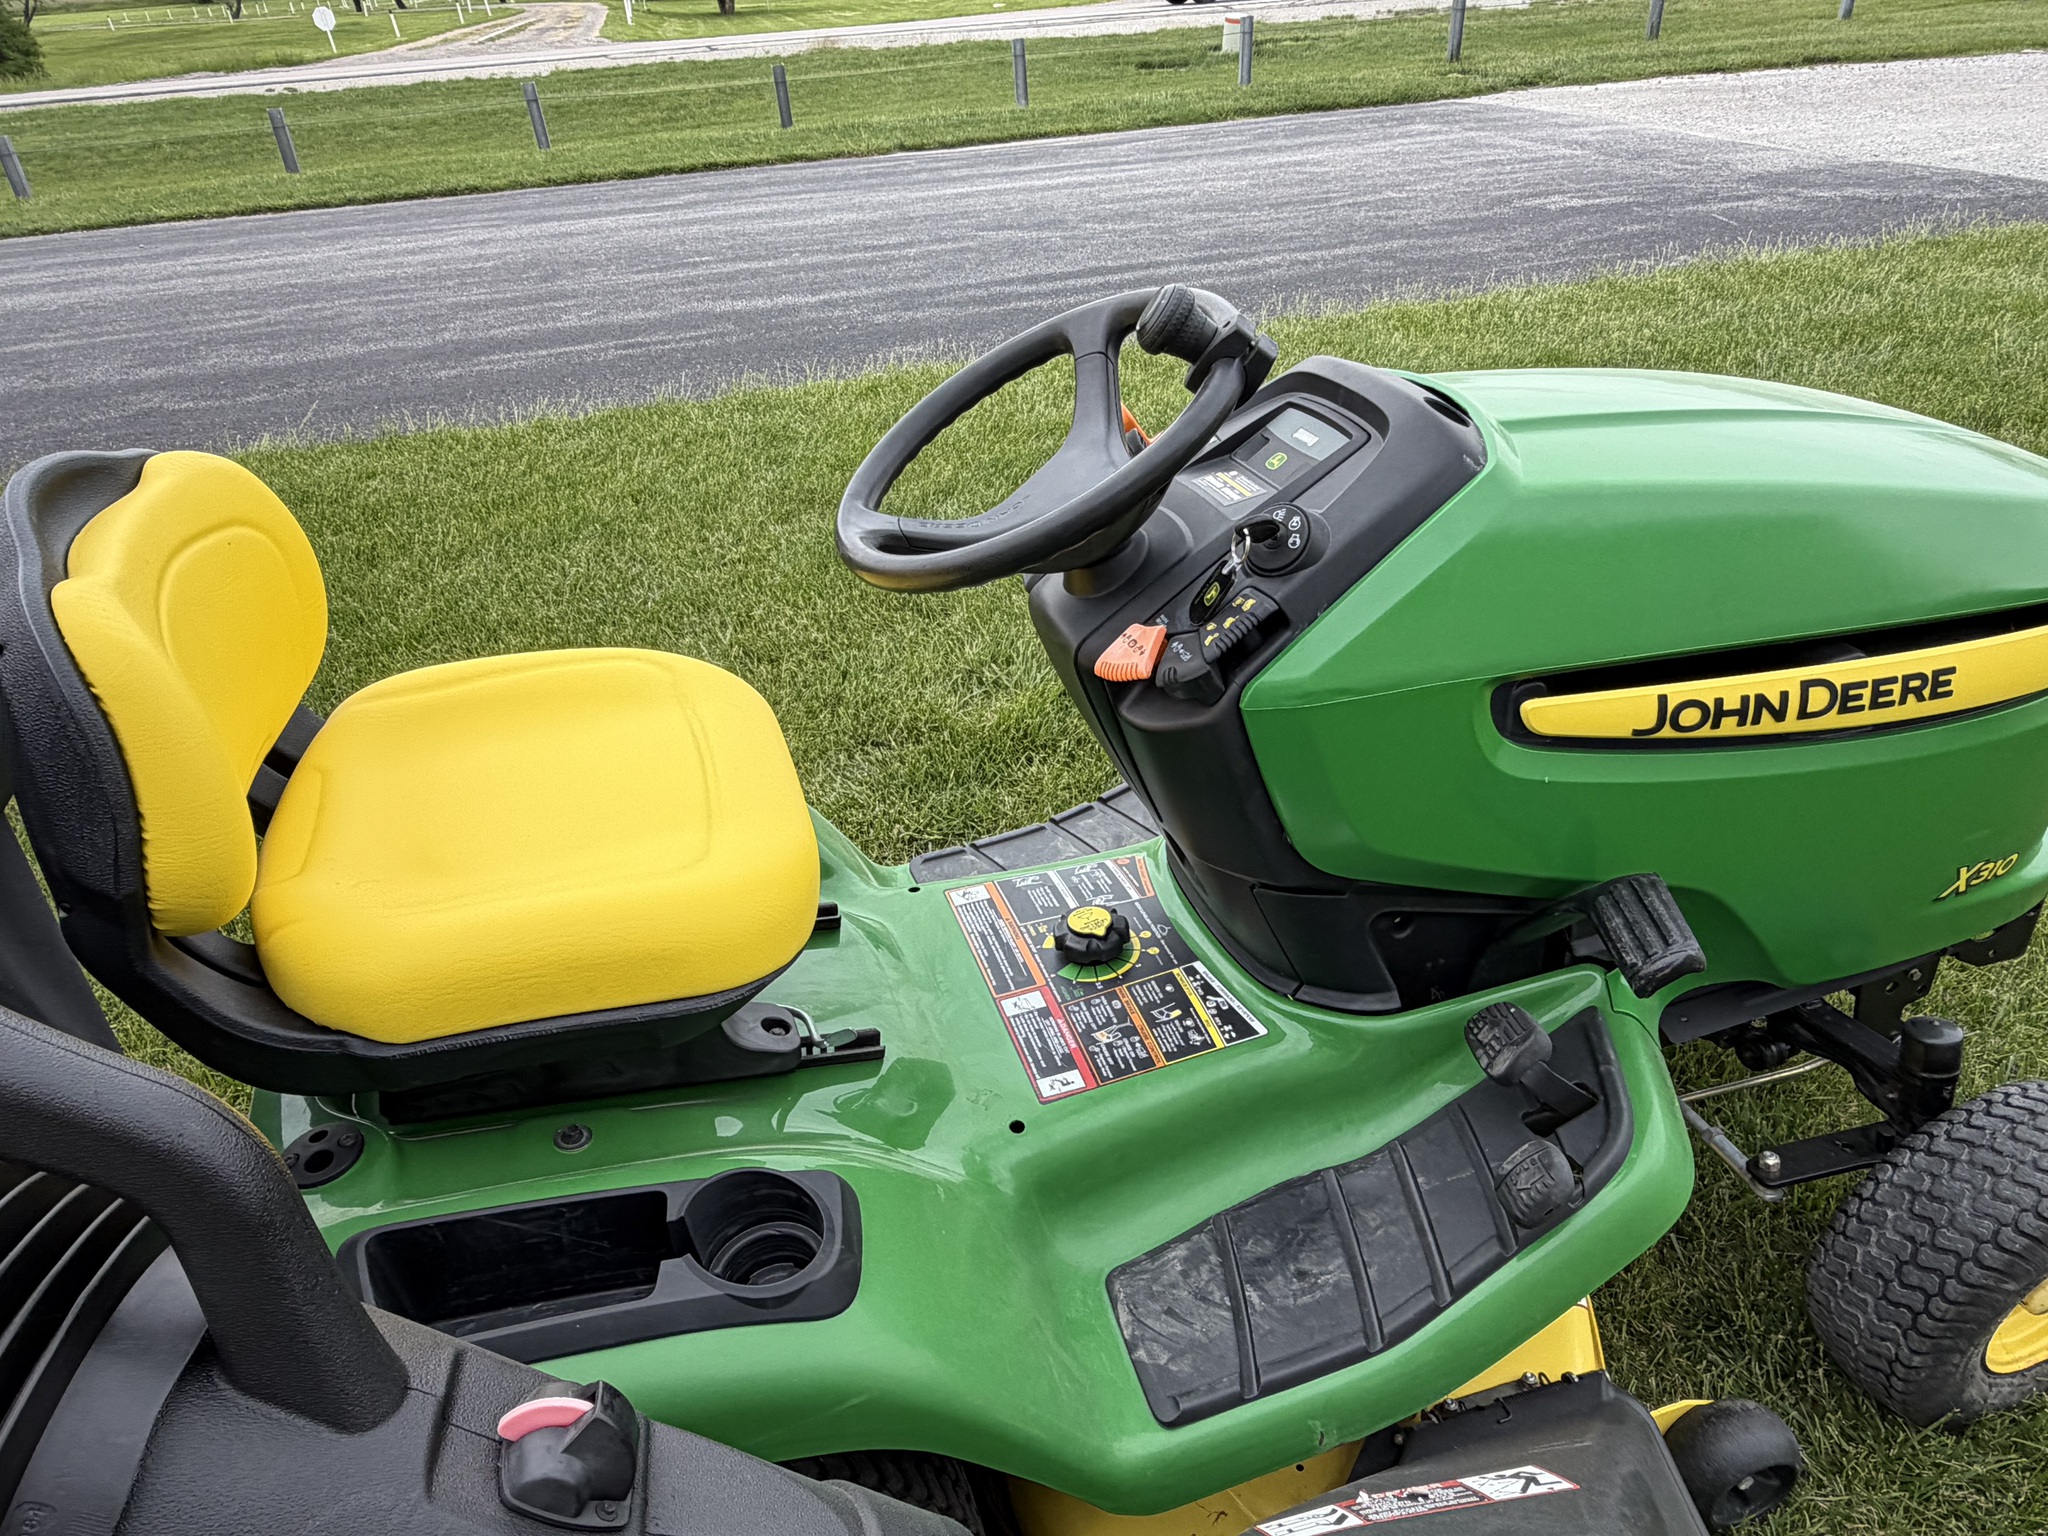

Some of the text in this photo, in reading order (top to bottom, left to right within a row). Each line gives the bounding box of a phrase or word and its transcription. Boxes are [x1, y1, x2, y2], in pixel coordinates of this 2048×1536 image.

[1631, 666, 1957, 737] JOHN DEERE
[1933, 852, 2019, 902] X310
[1060, 1022, 1077, 1049] DANGER
[1136, 1024, 1150, 1041] CRUISE
[1145, 1041, 1163, 1064] CONTROL
